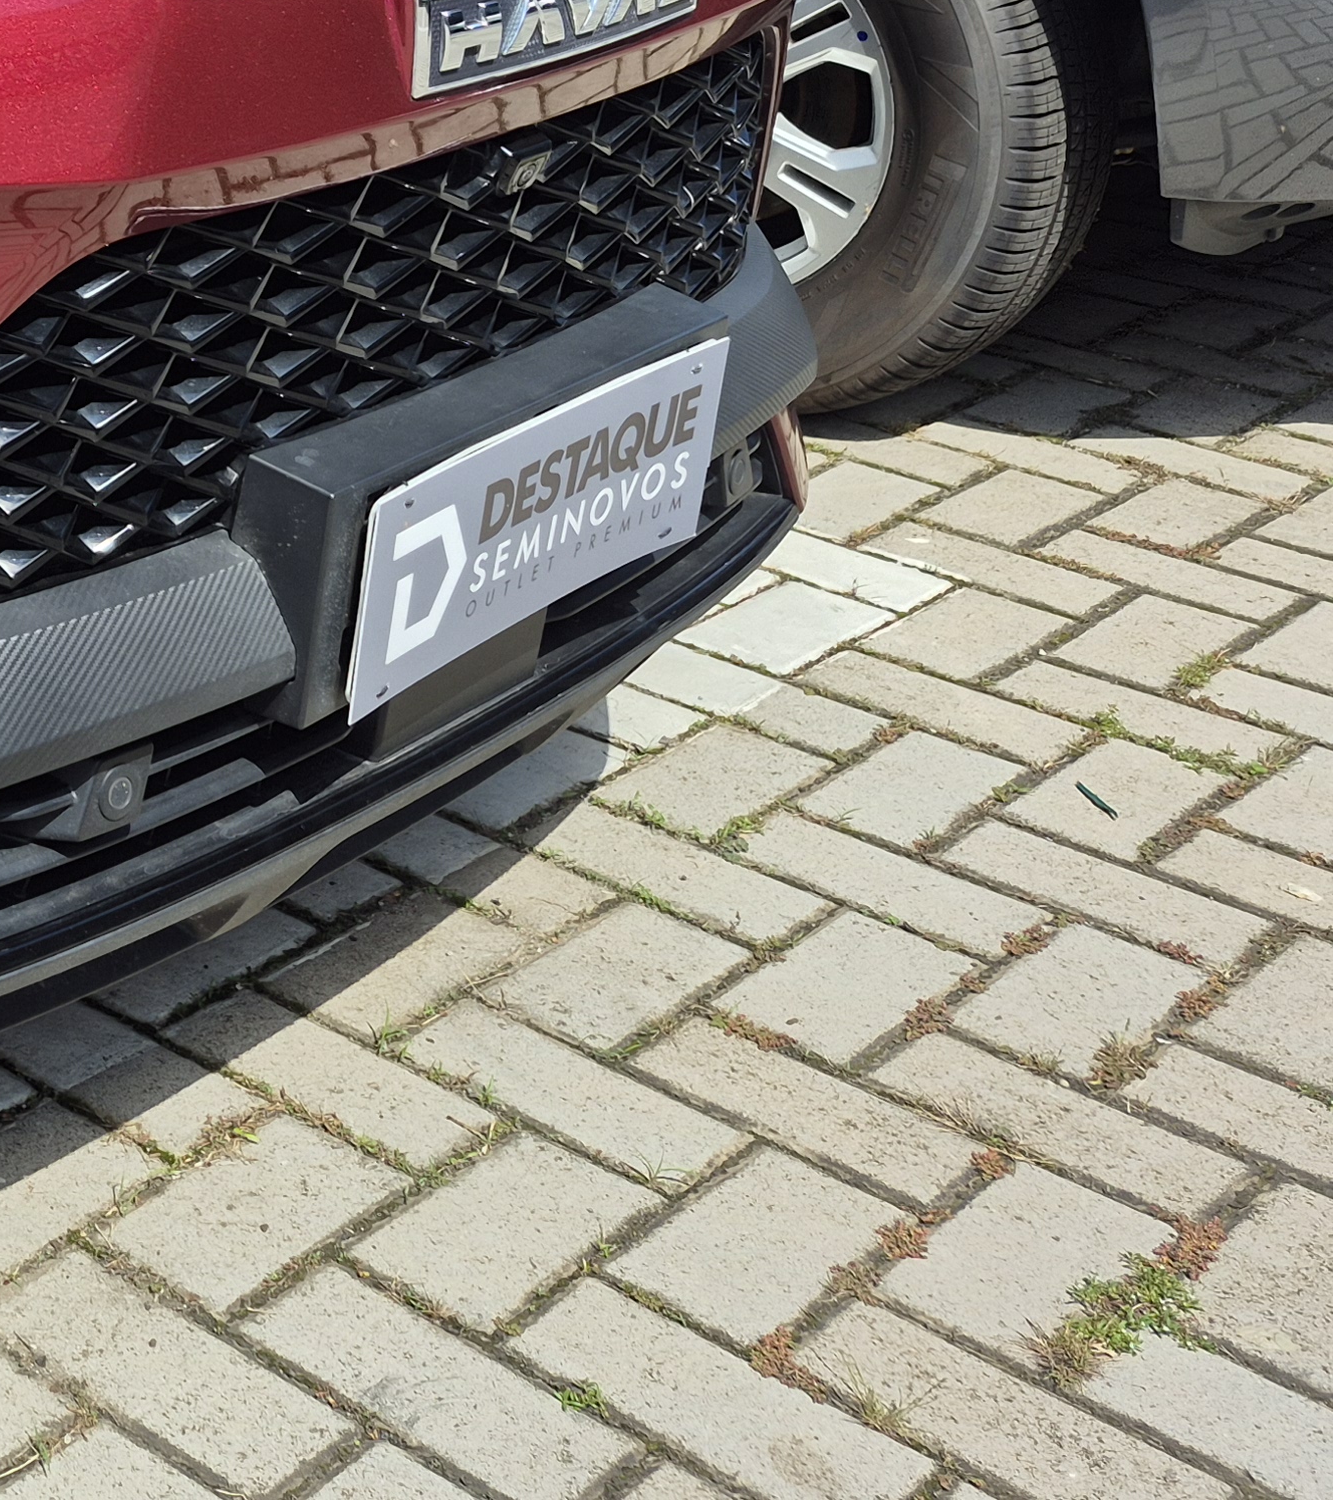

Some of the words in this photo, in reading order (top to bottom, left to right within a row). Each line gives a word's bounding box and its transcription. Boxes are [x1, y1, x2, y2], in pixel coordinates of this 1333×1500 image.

[469, 451, 691, 592] SEMINOVOS
[478, 384, 703, 545] DESTAQUE
[465, 555, 554, 617] OUTLET
[573, 496, 682, 558] PREMIUM
